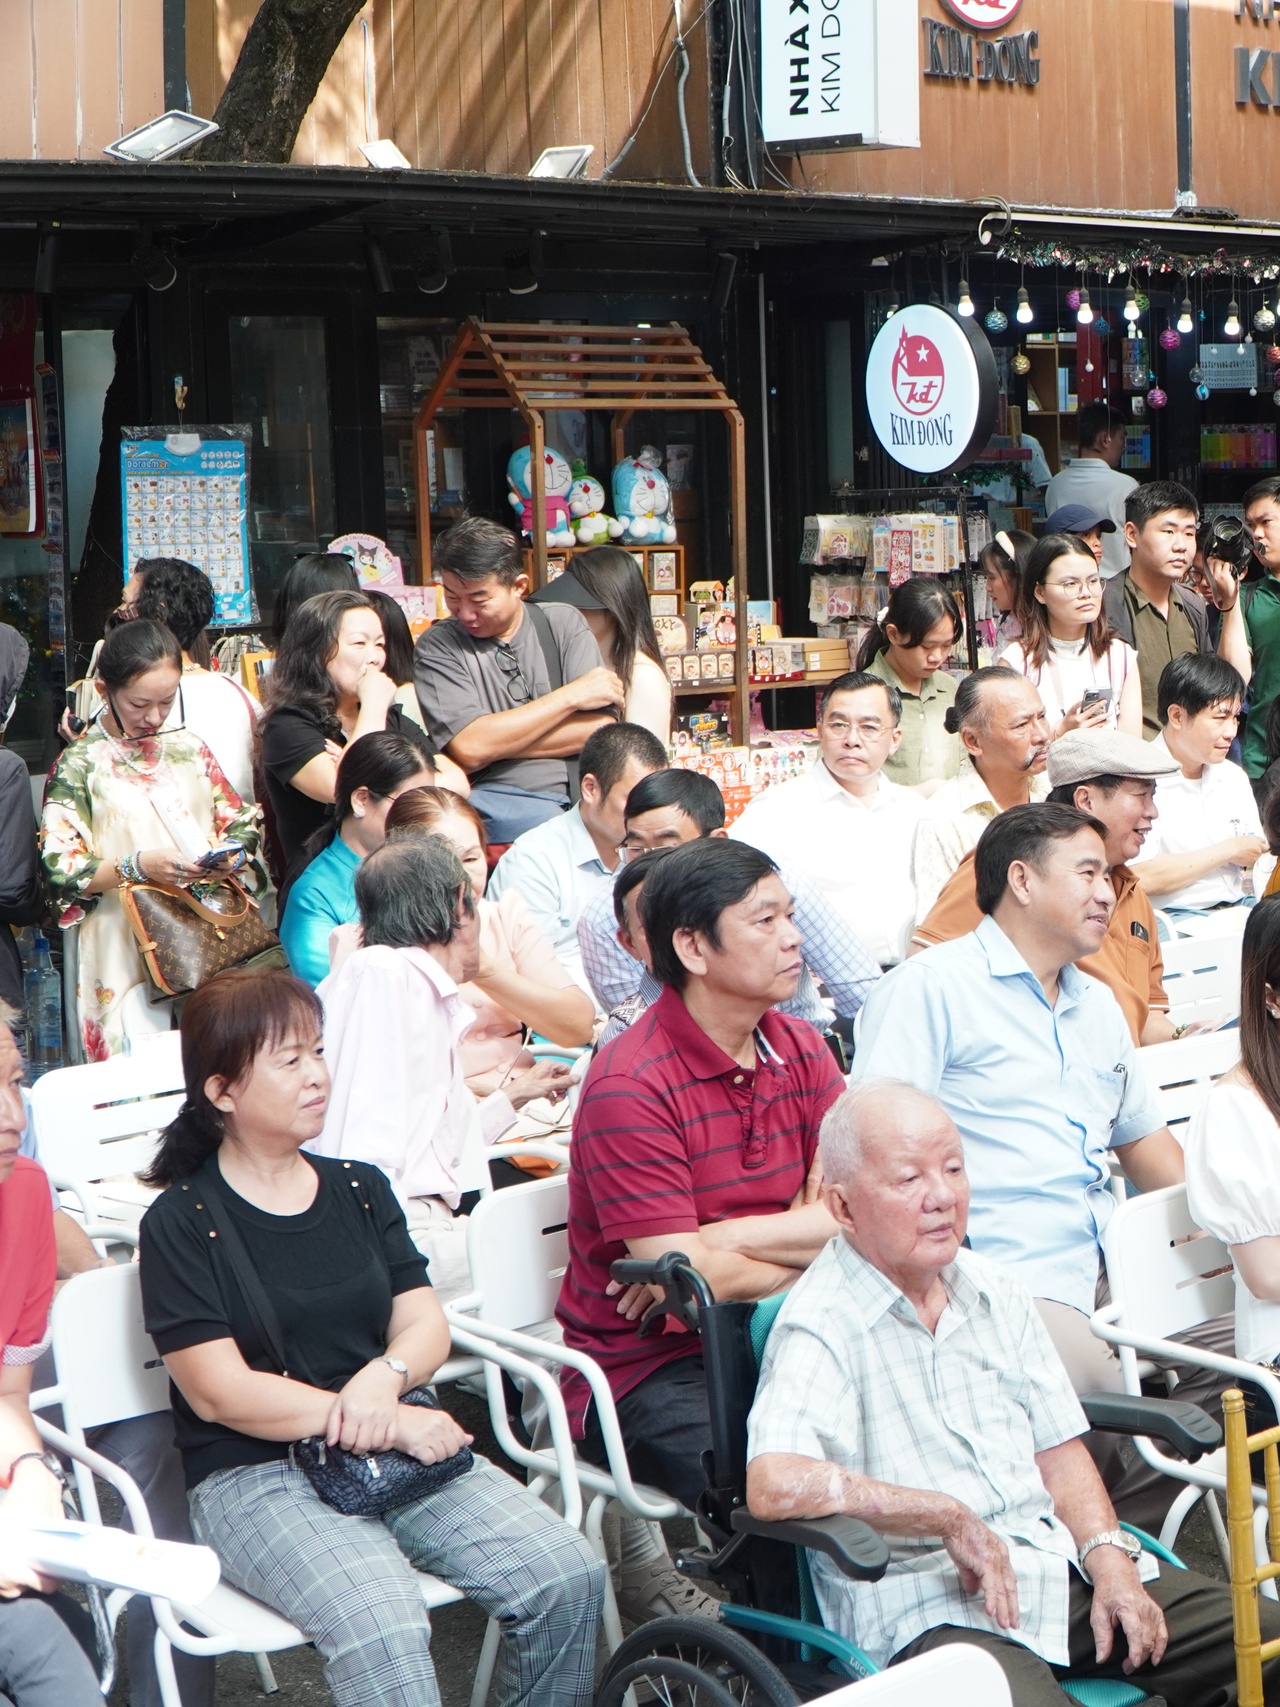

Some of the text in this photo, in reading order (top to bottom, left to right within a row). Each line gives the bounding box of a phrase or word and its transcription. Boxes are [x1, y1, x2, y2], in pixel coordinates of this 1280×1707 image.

[785, 23, 809, 116] NHÀ
[921, 17, 974, 79] KIM
[821, 52, 840, 113] KIM
[890, 412, 916, 446] KIM
